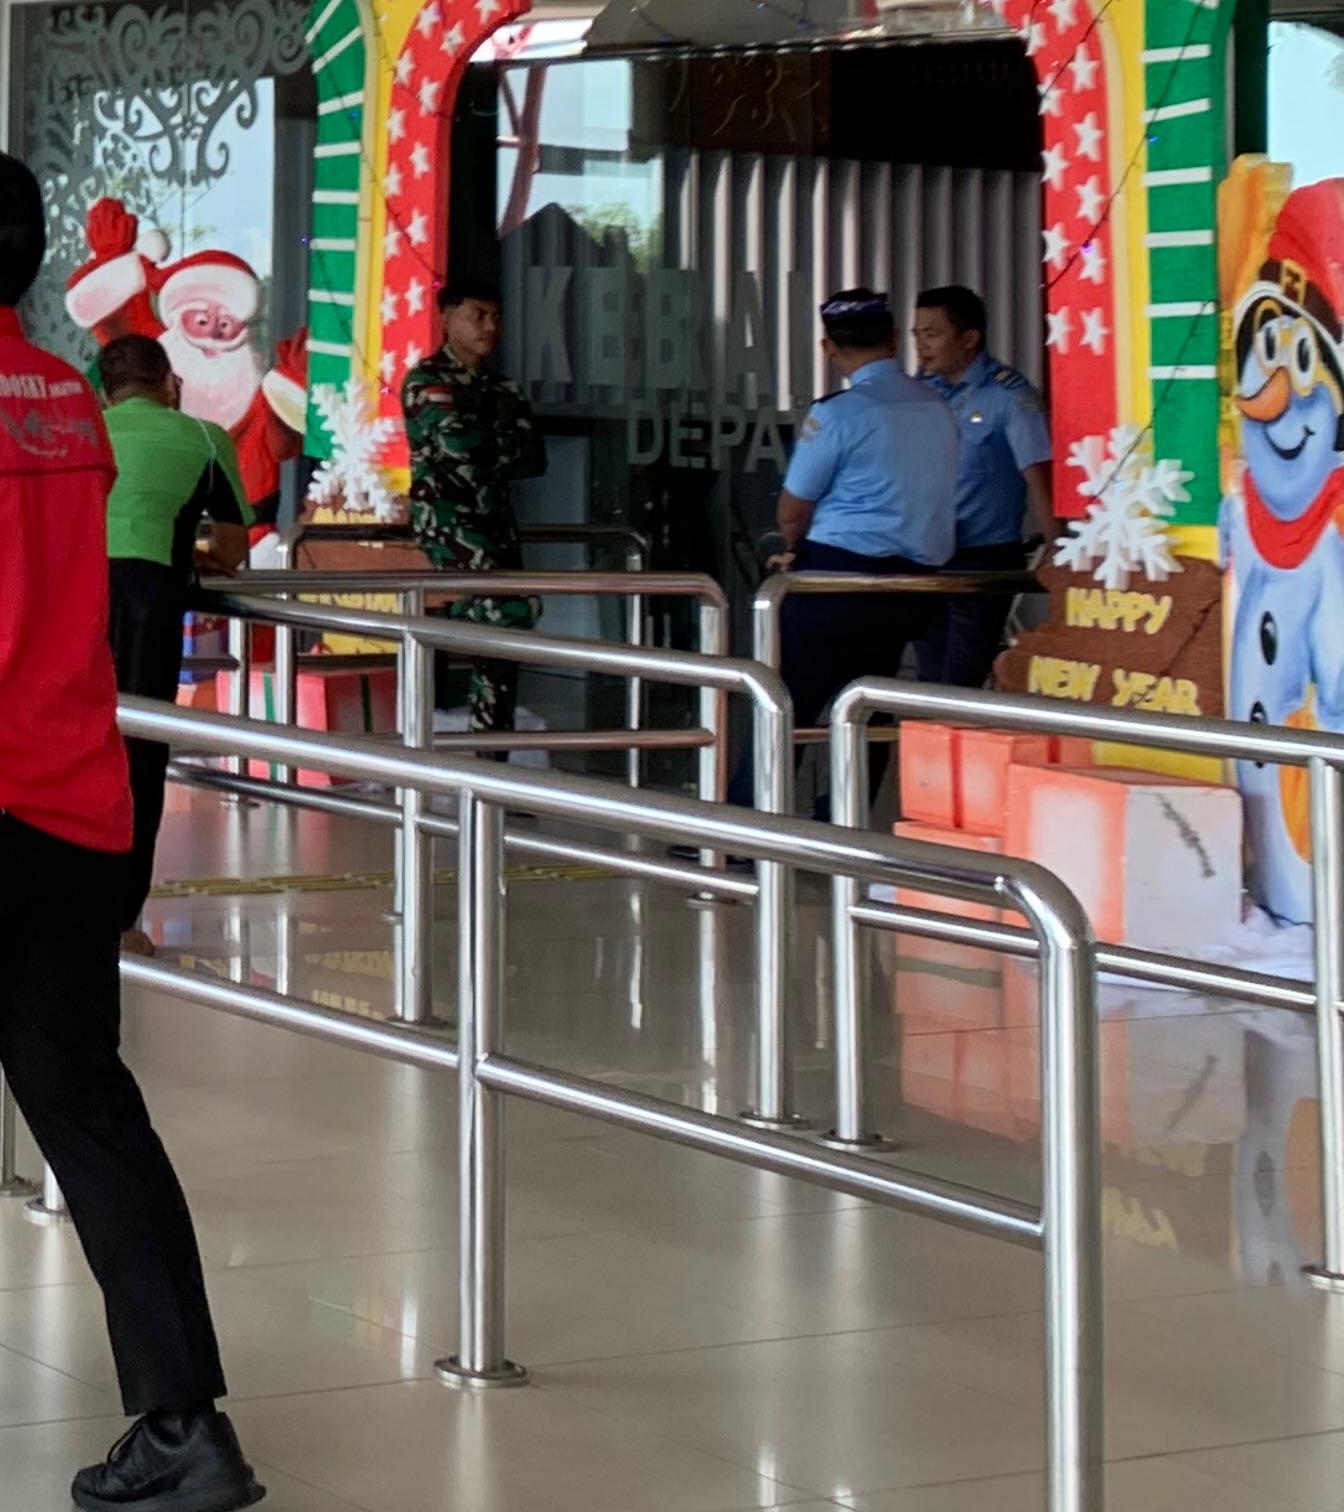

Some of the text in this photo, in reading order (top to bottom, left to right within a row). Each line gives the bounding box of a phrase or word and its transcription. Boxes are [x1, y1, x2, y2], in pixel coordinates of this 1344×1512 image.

[1066, 587, 1173, 634] HAPPY
[1028, 655, 1201, 716] NEW YEAR
